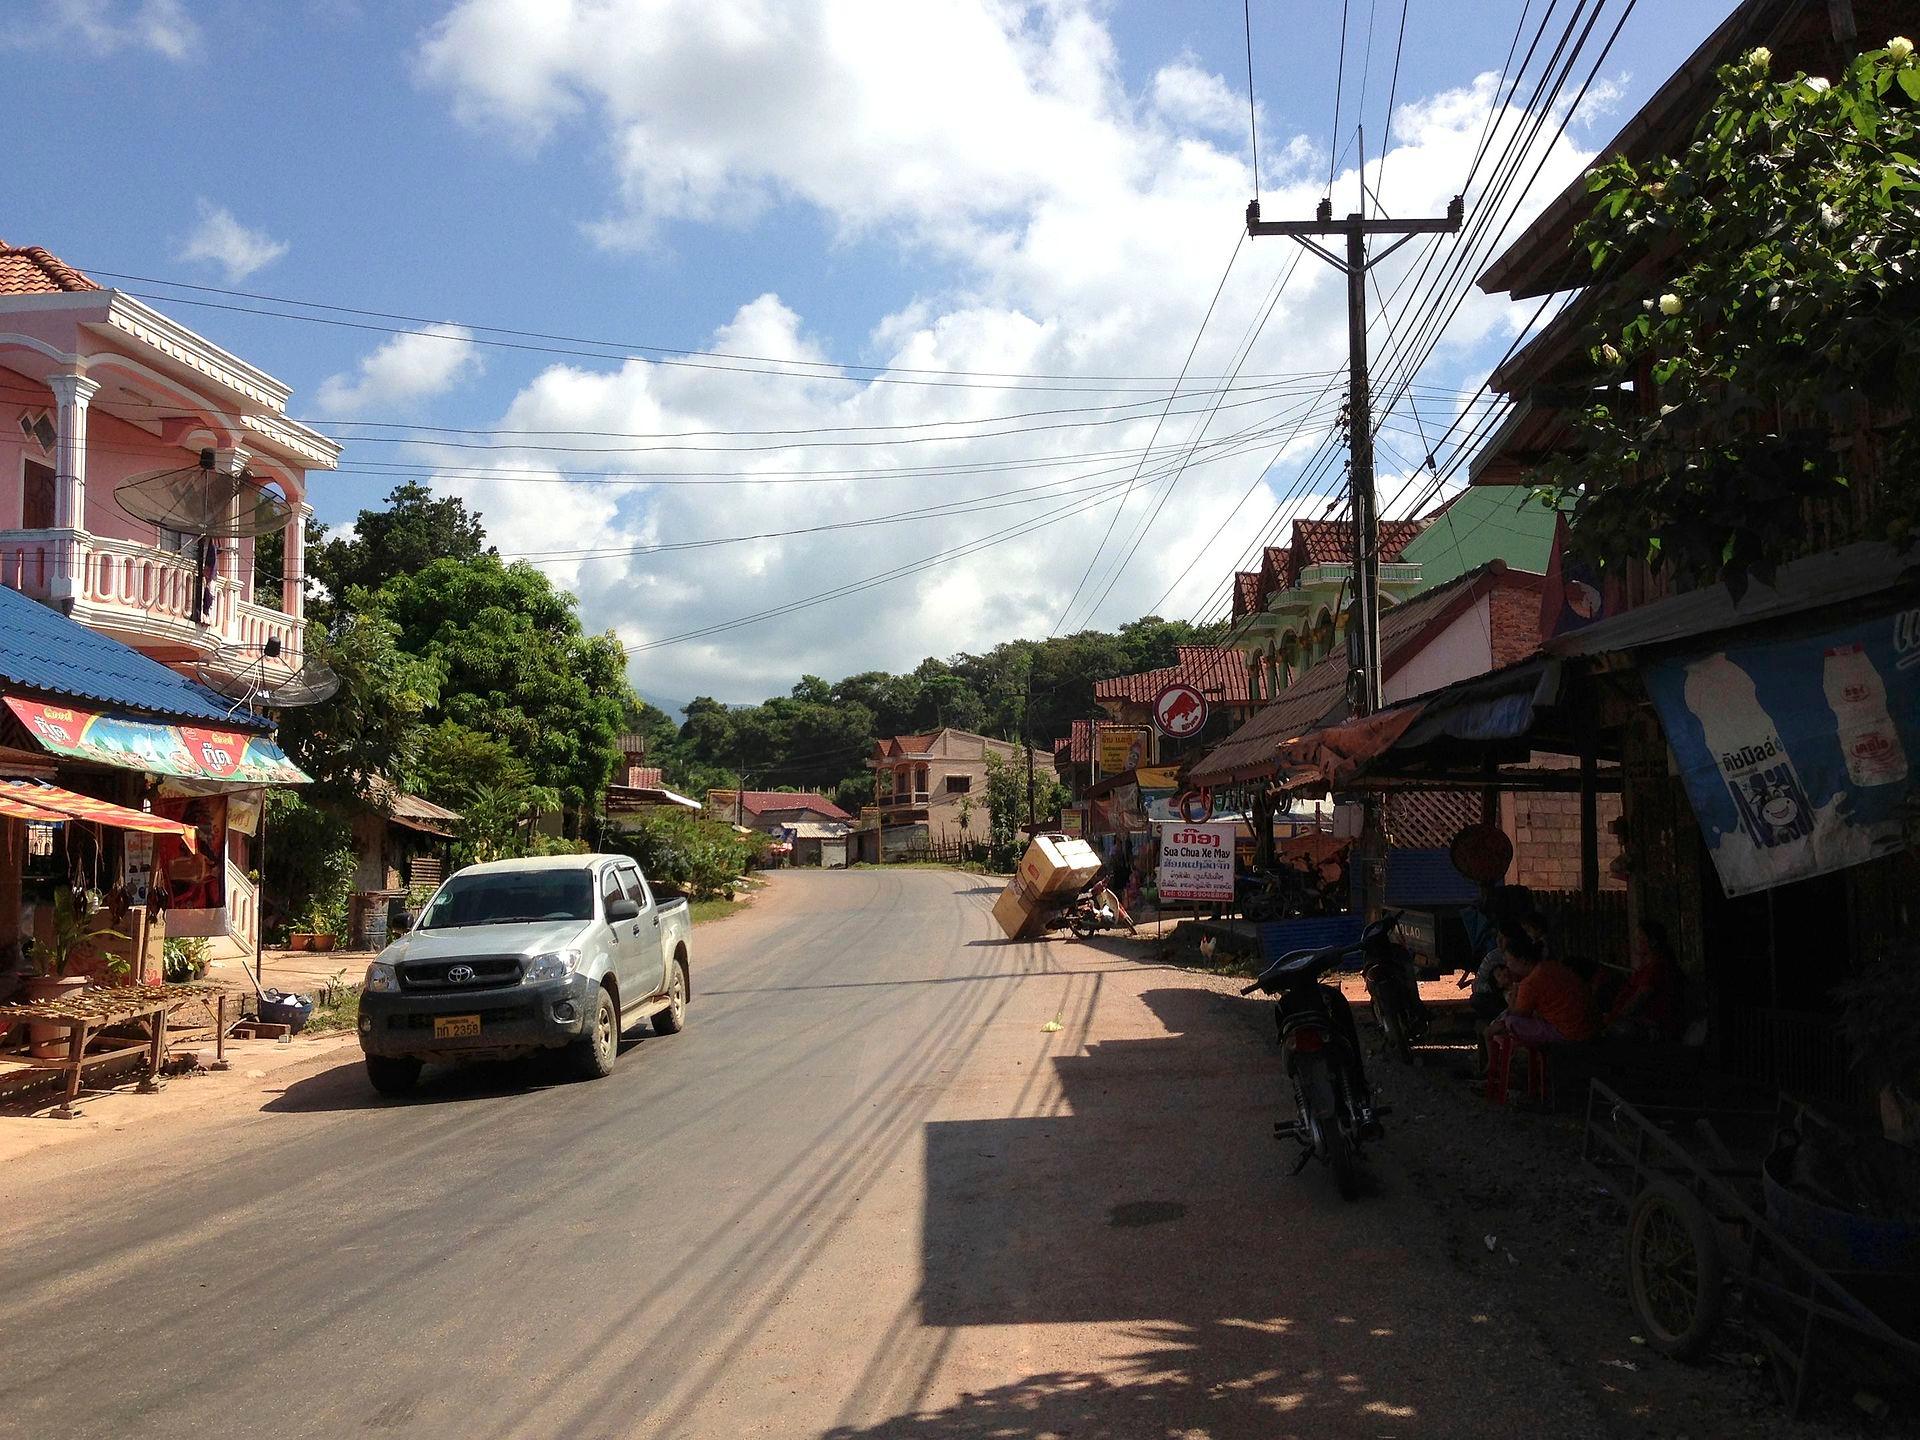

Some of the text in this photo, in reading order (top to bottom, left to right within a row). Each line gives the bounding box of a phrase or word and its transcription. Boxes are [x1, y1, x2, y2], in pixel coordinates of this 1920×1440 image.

[1164, 846, 1231, 859] Sua Chua Xe May
